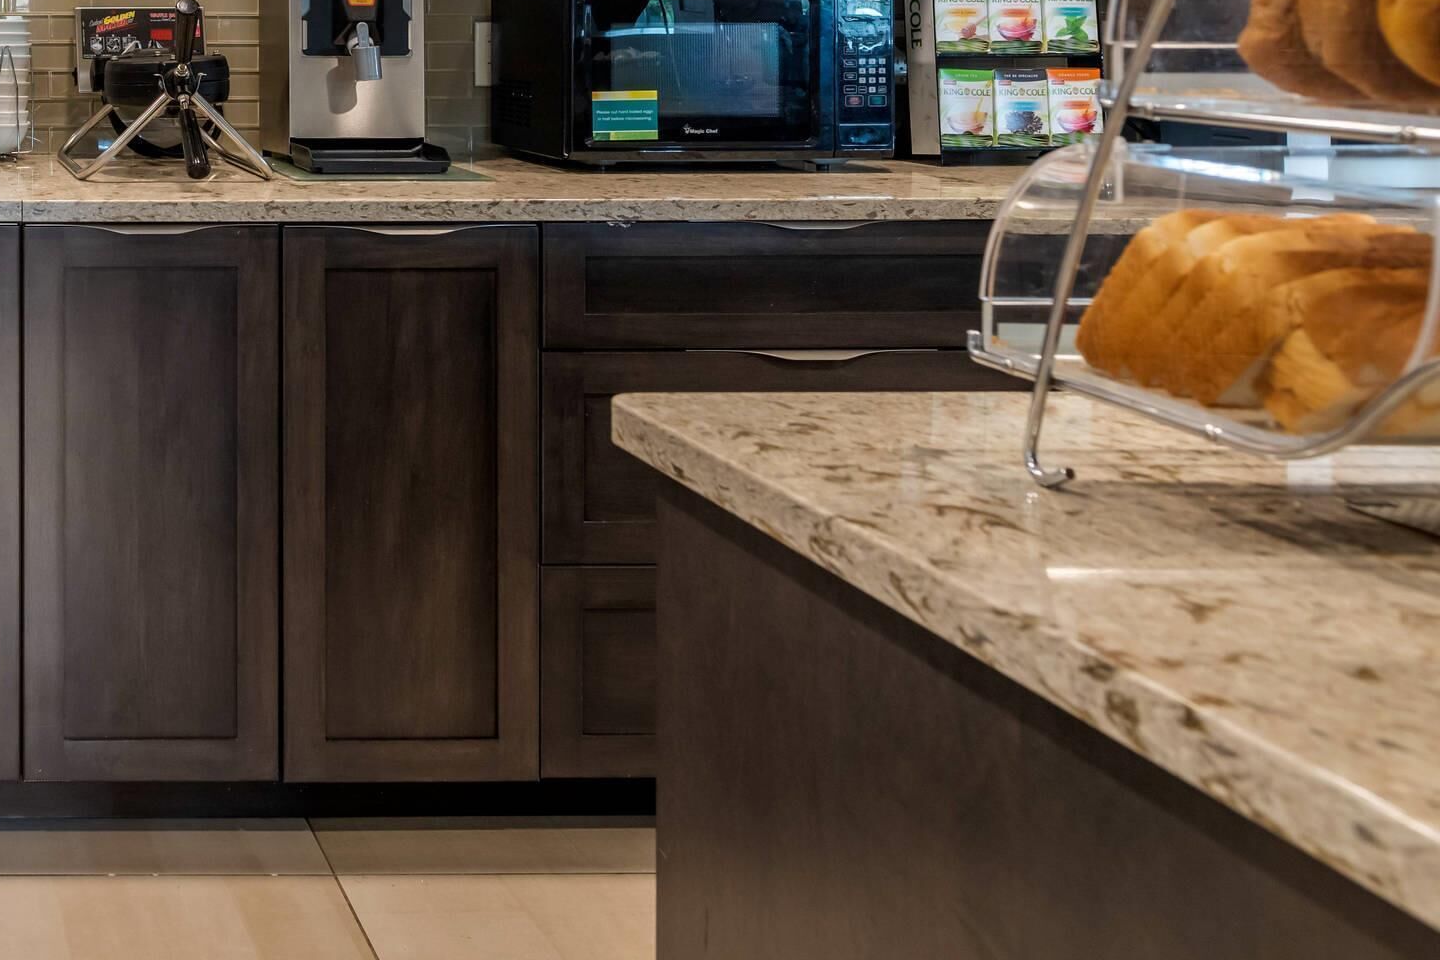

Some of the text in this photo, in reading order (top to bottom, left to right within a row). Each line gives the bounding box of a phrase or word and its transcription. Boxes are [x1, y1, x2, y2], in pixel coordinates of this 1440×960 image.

[103, 10, 136, 25] GOLDEN
[943, 88, 991, 96] KING COLE
[999, 88, 1047, 96] KING COLE
[1052, 87, 1072, 95] KING
